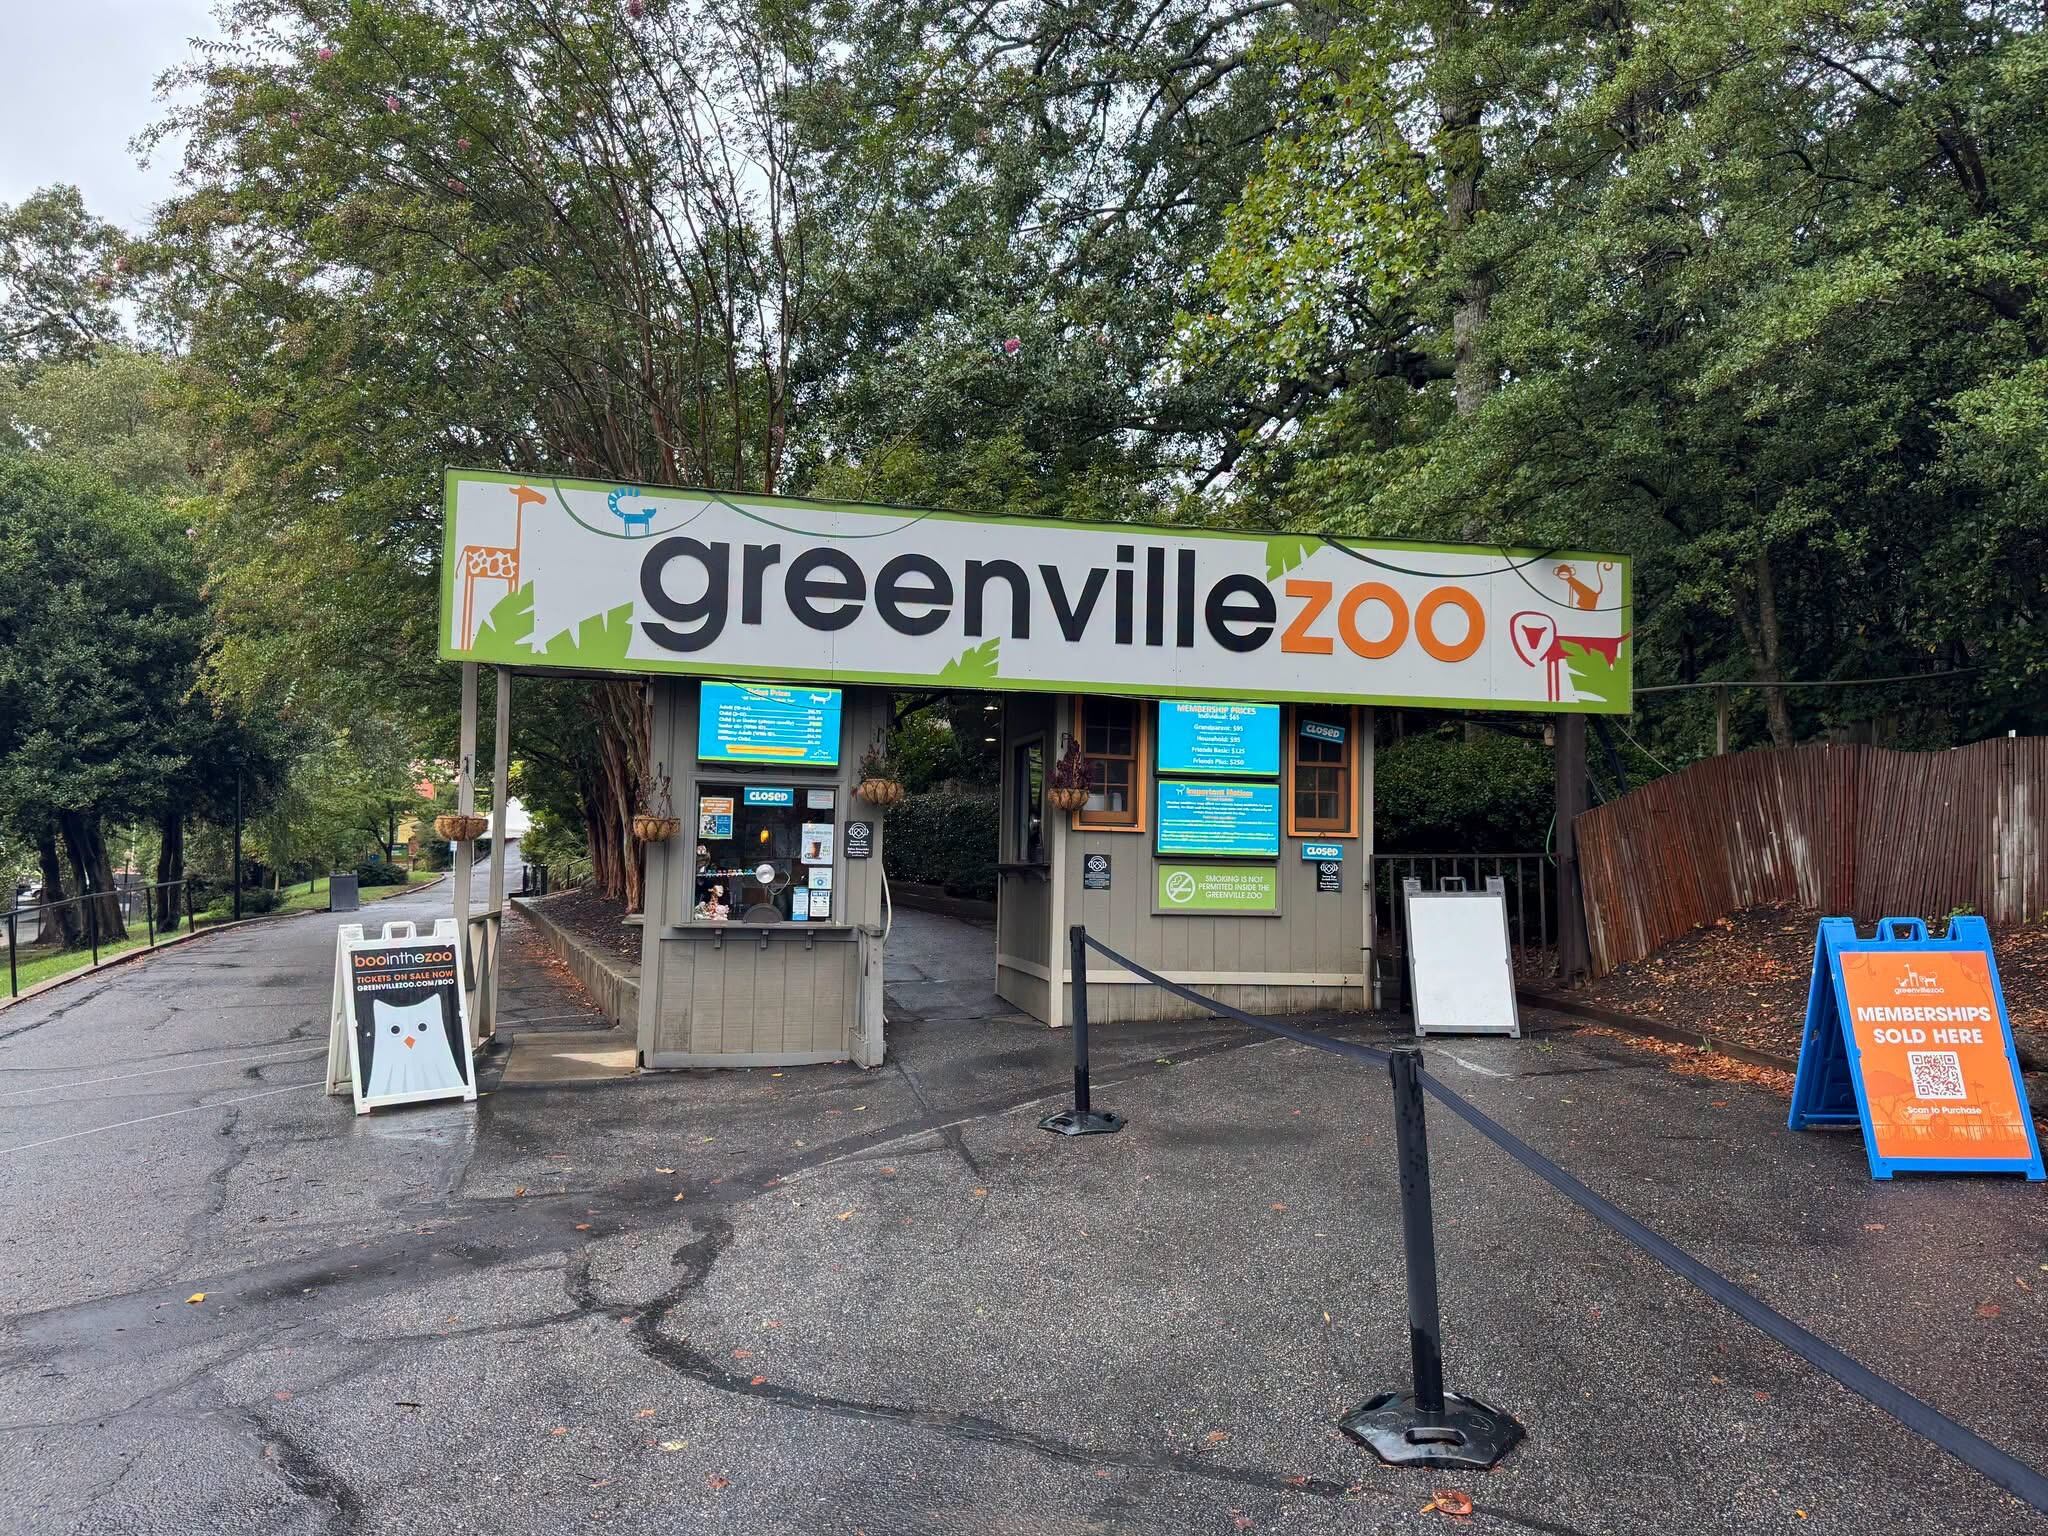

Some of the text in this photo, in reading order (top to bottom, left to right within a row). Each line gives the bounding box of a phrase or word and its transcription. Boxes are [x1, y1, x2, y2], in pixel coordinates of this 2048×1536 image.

[1177, 704, 1257, 715] MEMBERSHIP PRICES
[1205, 874, 1264, 884] SMOKING IS NOT
[1198, 882, 1270, 892] PERMITTED INSIDE THE
[1205, 891, 1263, 899] GREENVILLE ZOO
[357, 970, 454, 984] TICKETS ON SALE NOW
[357, 978, 454, 992] GREENVILLEZOO.COM/BOO
[1894, 987, 1944, 995] greenvillezoo
[1857, 1007, 1991, 1022] MEMBERSHIPS
[1873, 1028, 1984, 1044] SOLD HERE
[1907, 1105, 1982, 1115] Scan to Purchase
